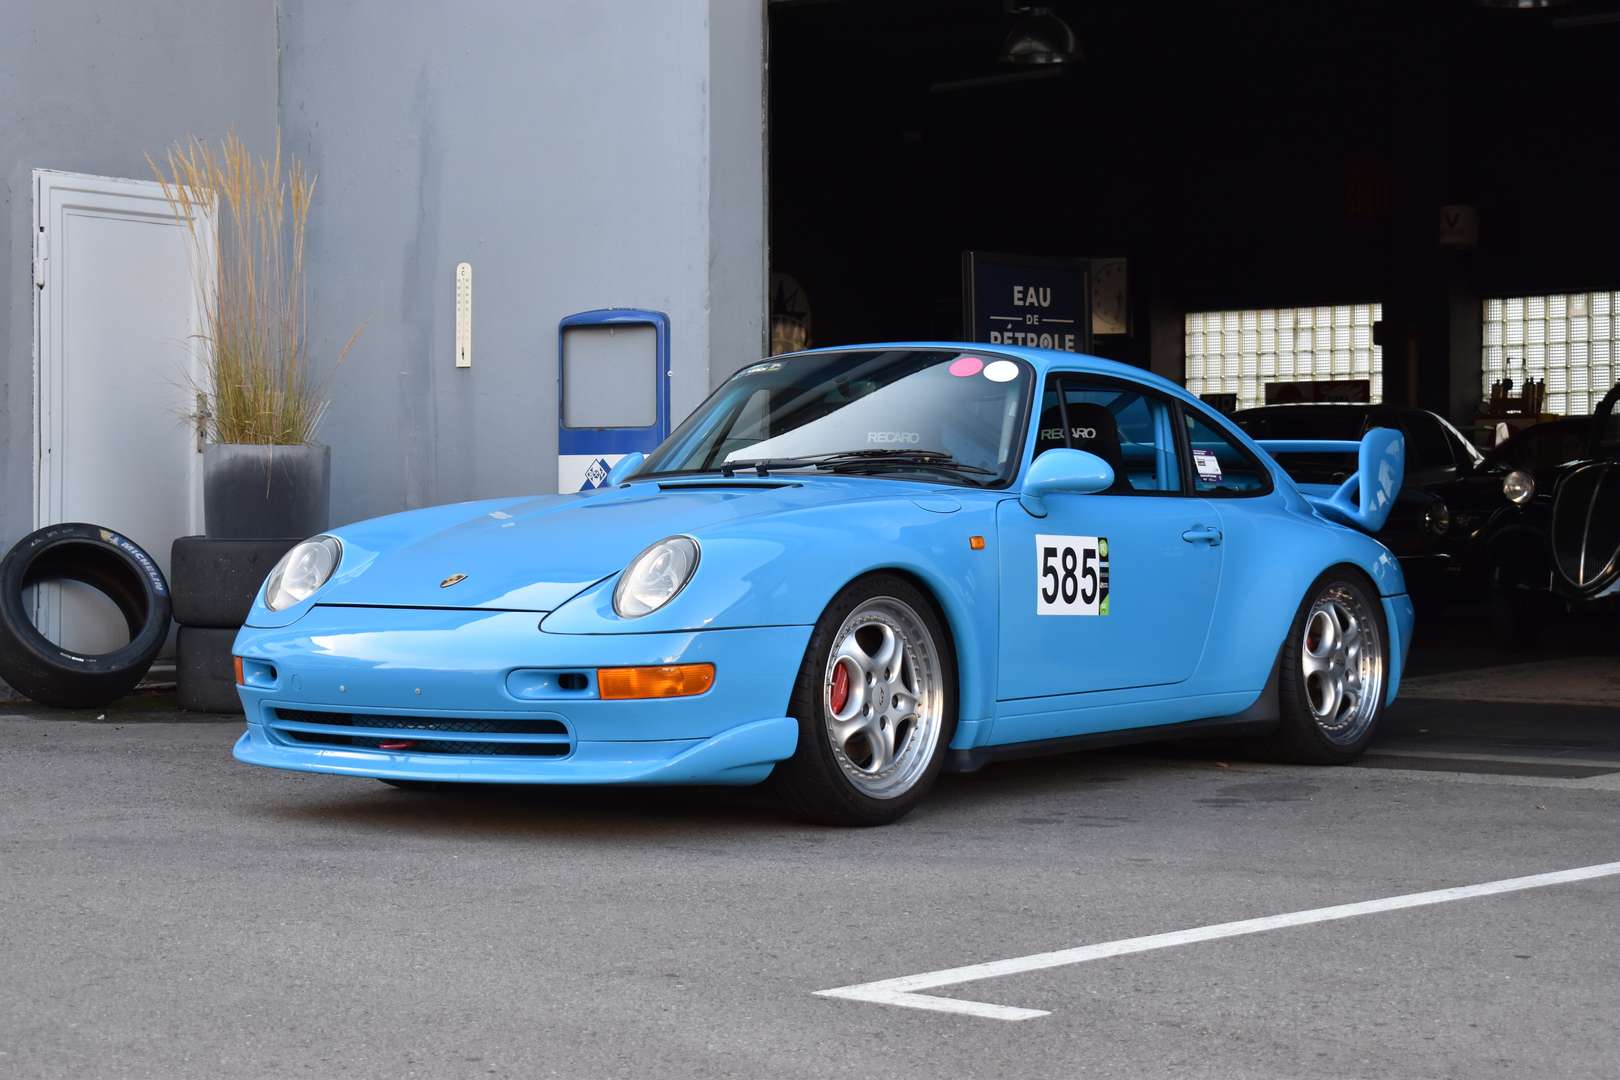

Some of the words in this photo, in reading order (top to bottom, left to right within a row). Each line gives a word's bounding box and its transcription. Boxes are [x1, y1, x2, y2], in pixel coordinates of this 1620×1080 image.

[1013, 285, 1051, 307] EAU
[1026, 314, 1039, 325] DE
[990, 322, 1076, 352] PÉTROLE
[867, 431, 920, 444] RECARO
[120, 541, 164, 591] MICHELIN
[1041, 547, 1098, 604] 585
